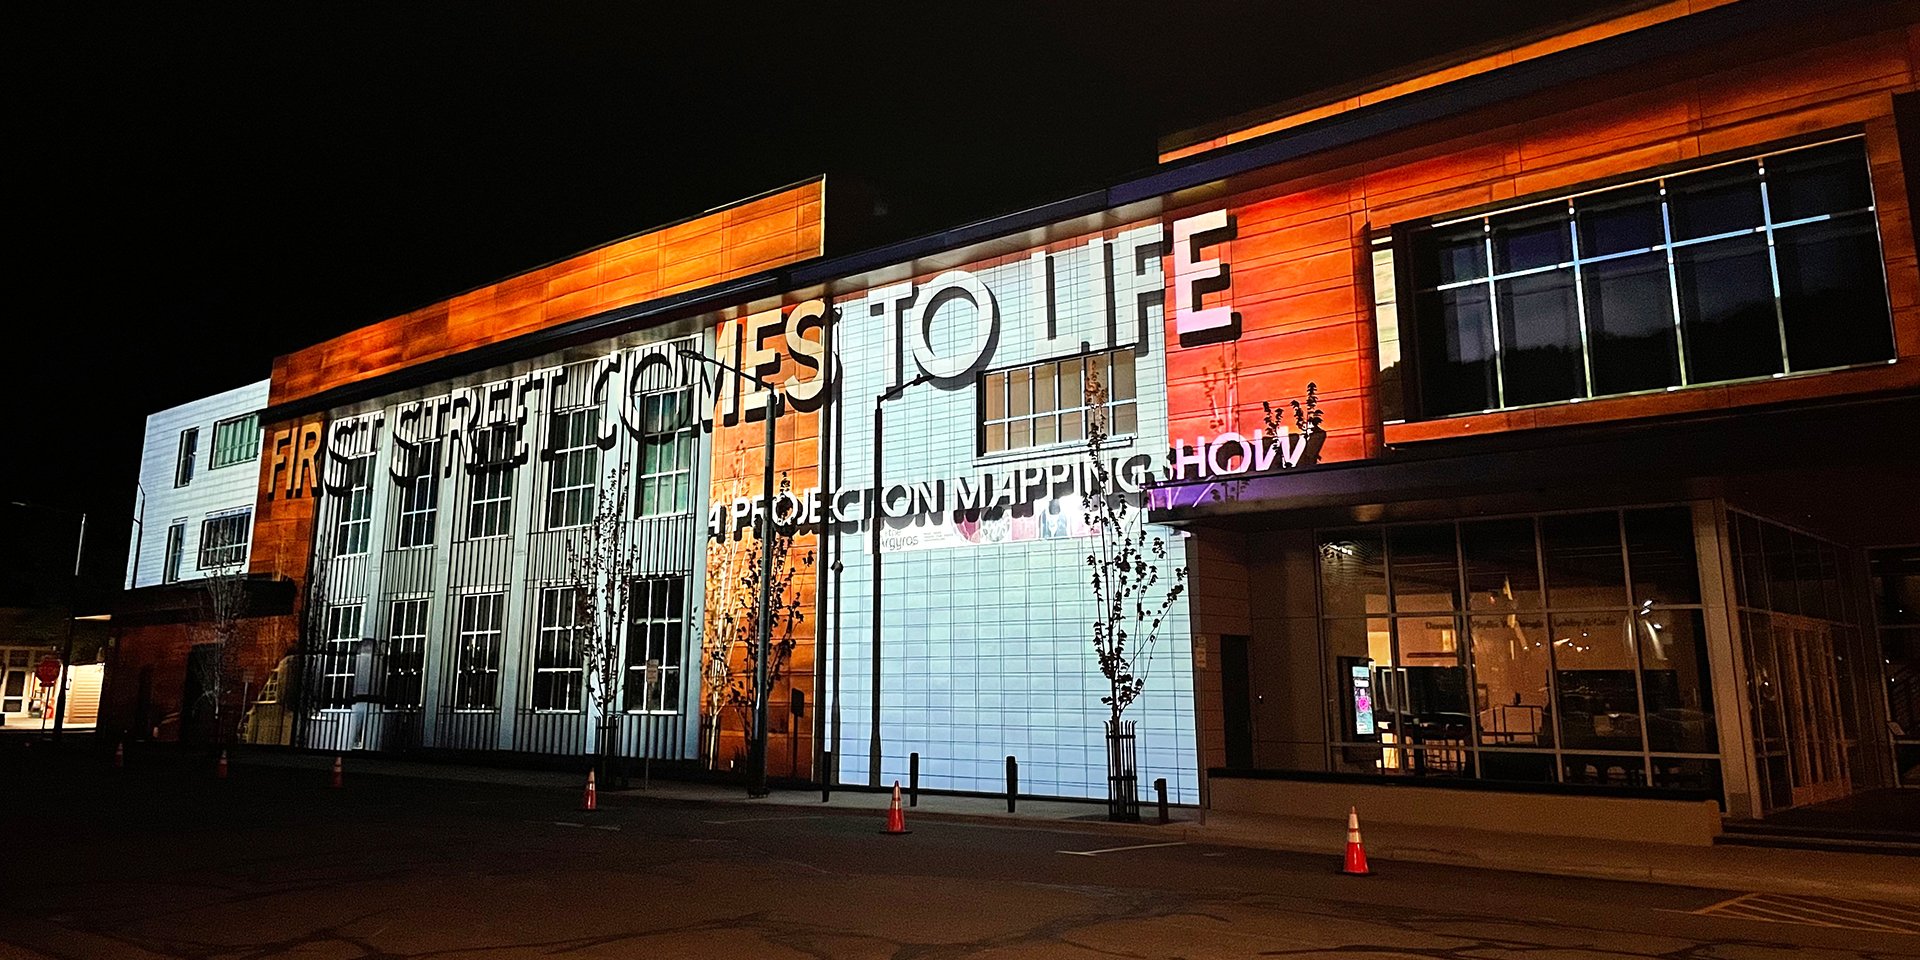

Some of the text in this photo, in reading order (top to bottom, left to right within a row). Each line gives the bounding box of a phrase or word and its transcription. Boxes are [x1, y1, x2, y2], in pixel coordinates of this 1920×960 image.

[588, 299, 841, 449] COMES
[867, 270, 999, 391] TO
[1030, 208, 1237, 357] LIFE
[707, 500, 723, 536] A
[954, 454, 1149, 513] MAPPING
